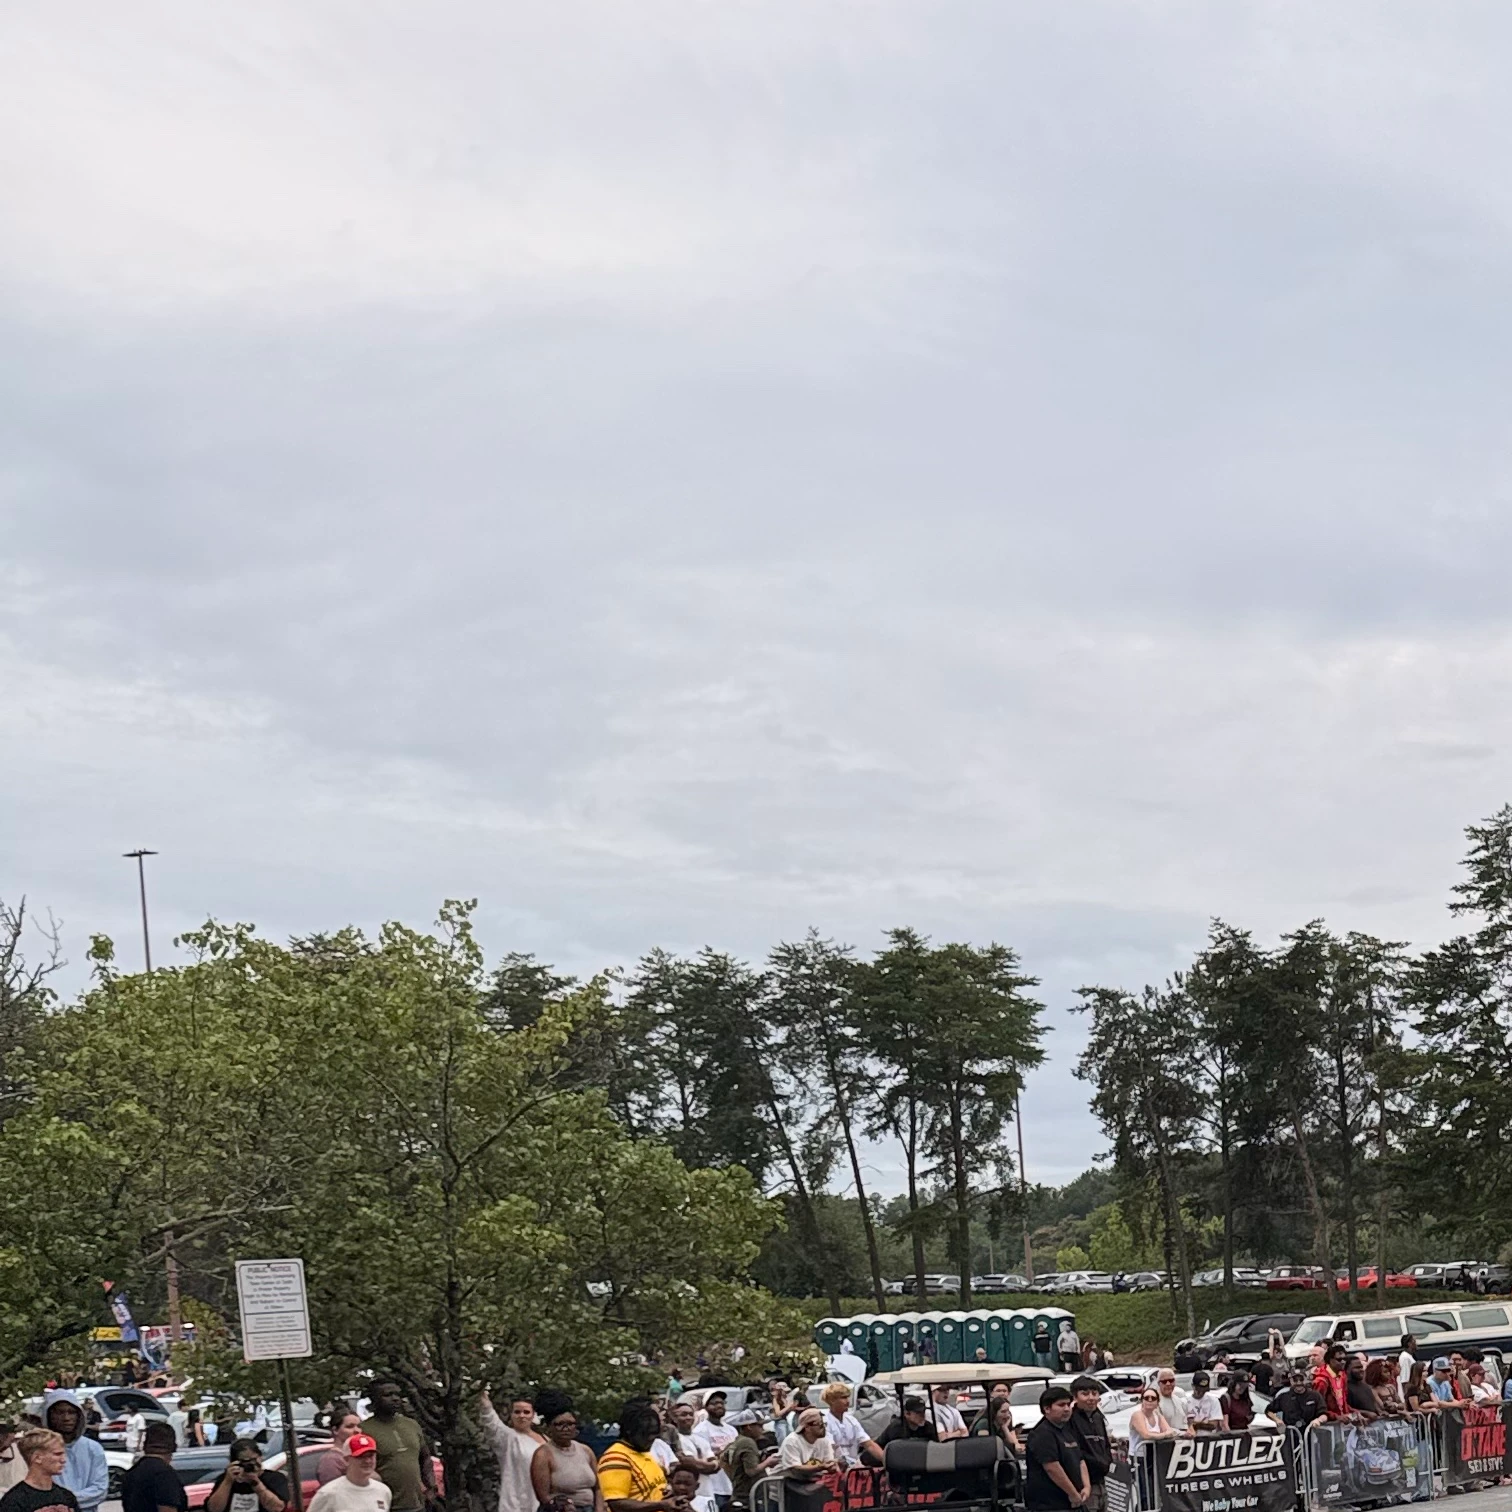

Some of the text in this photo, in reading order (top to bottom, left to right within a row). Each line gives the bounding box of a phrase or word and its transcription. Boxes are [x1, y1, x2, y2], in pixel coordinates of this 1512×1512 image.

[1165, 1433, 1286, 1479] BUTLER
[1165, 1470, 1287, 1493] TIRES & WHEELS
[1202, 1495, 1259, 1512] We Baby Your Car
